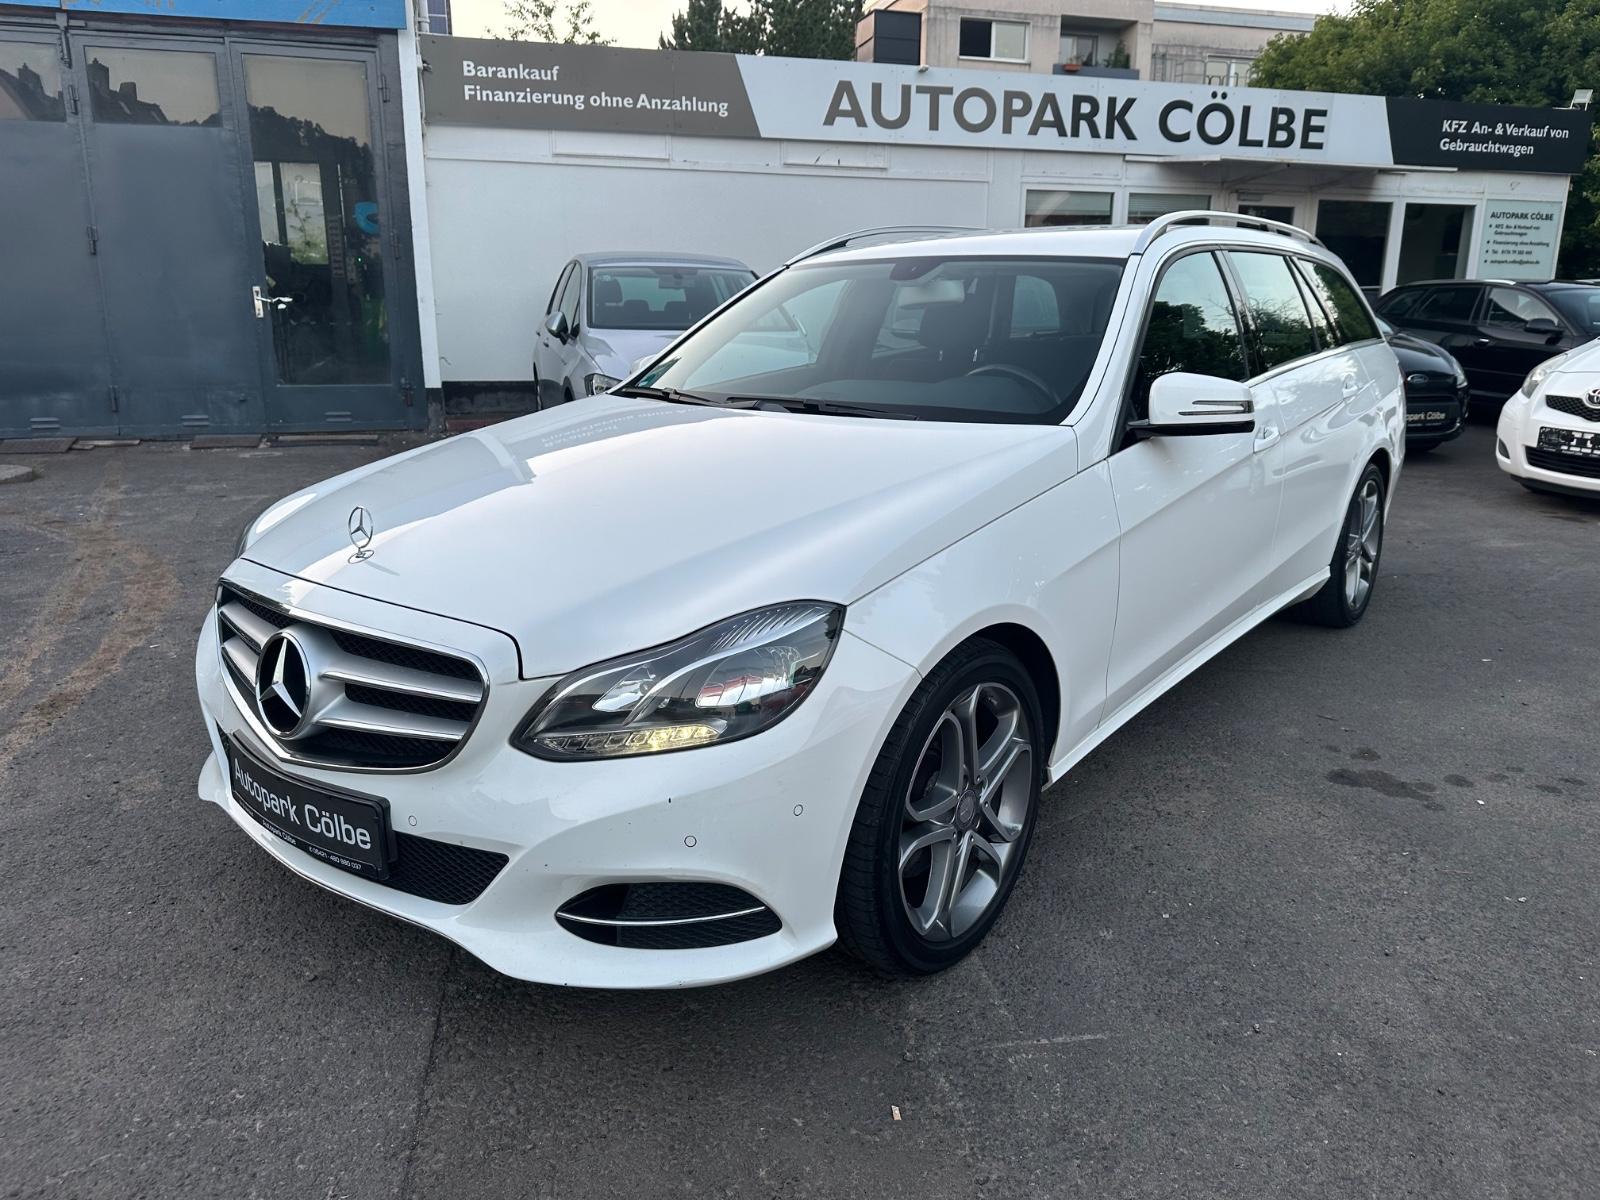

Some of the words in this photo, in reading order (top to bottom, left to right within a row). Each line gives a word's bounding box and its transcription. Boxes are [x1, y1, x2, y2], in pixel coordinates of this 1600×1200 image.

[462, 60, 560, 81] Barankauf
[464, 84, 585, 110] Finanzierung
[589, 93, 633, 108] ohne
[636, 93, 729, 117] Anzahlung
[822, 79, 1138, 141] AUTOPARK
[1157, 90, 1329, 150] CÖLBE
[1442, 119, 1468, 133] KFZ
[1471, 121, 1493, 134] An-
[1494, 123, 1504, 135] &
[1505, 123, 1549, 138] Verkauf
[1550, 128, 1569, 139] von
[1440, 138, 1534, 157] Gebrauchtwagen
[1490, 211, 1529, 220] AUTOPARK
[234, 758, 301, 825] Autopark
[304, 803, 372, 850] Cölbe
